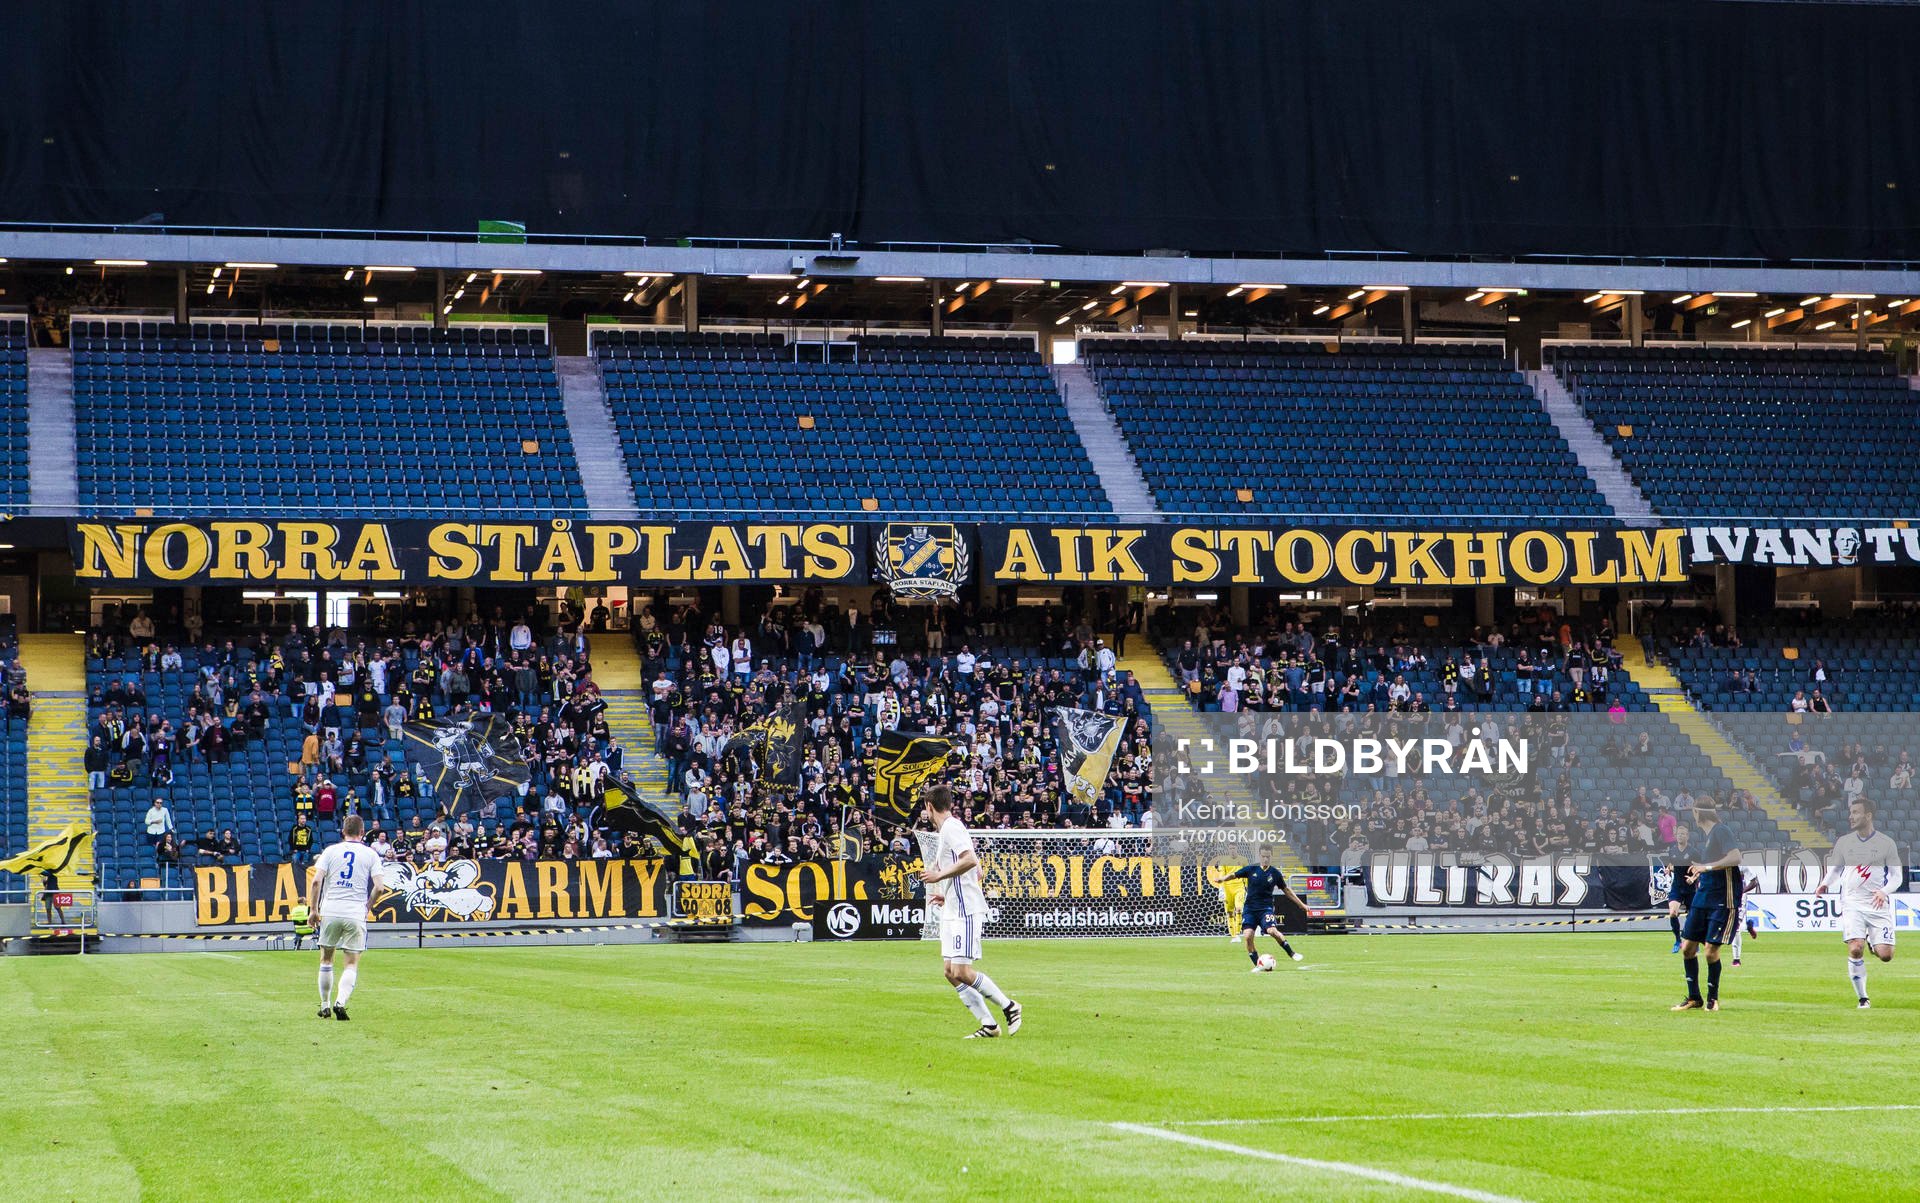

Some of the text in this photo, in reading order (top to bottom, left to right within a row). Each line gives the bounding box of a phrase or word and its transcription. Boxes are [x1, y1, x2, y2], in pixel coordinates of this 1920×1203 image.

[75, 519, 855, 582] NORRA STÅPLATS
[994, 528, 1690, 584] AIK STOCKHOLM
[894, 579, 917, 587] NORRA
[340, 851, 356, 880] 3
[1308, 879, 1322, 888] 120
[1369, 850, 1592, 905] ULTRAS
[55, 895, 72, 905] 122
[195, 860, 664, 926] BLA ARMY
[1025, 907, 1174, 928] metalshake.com
[1795, 898, 1843, 918] sau
[1797, 920, 1837, 928] SWE
